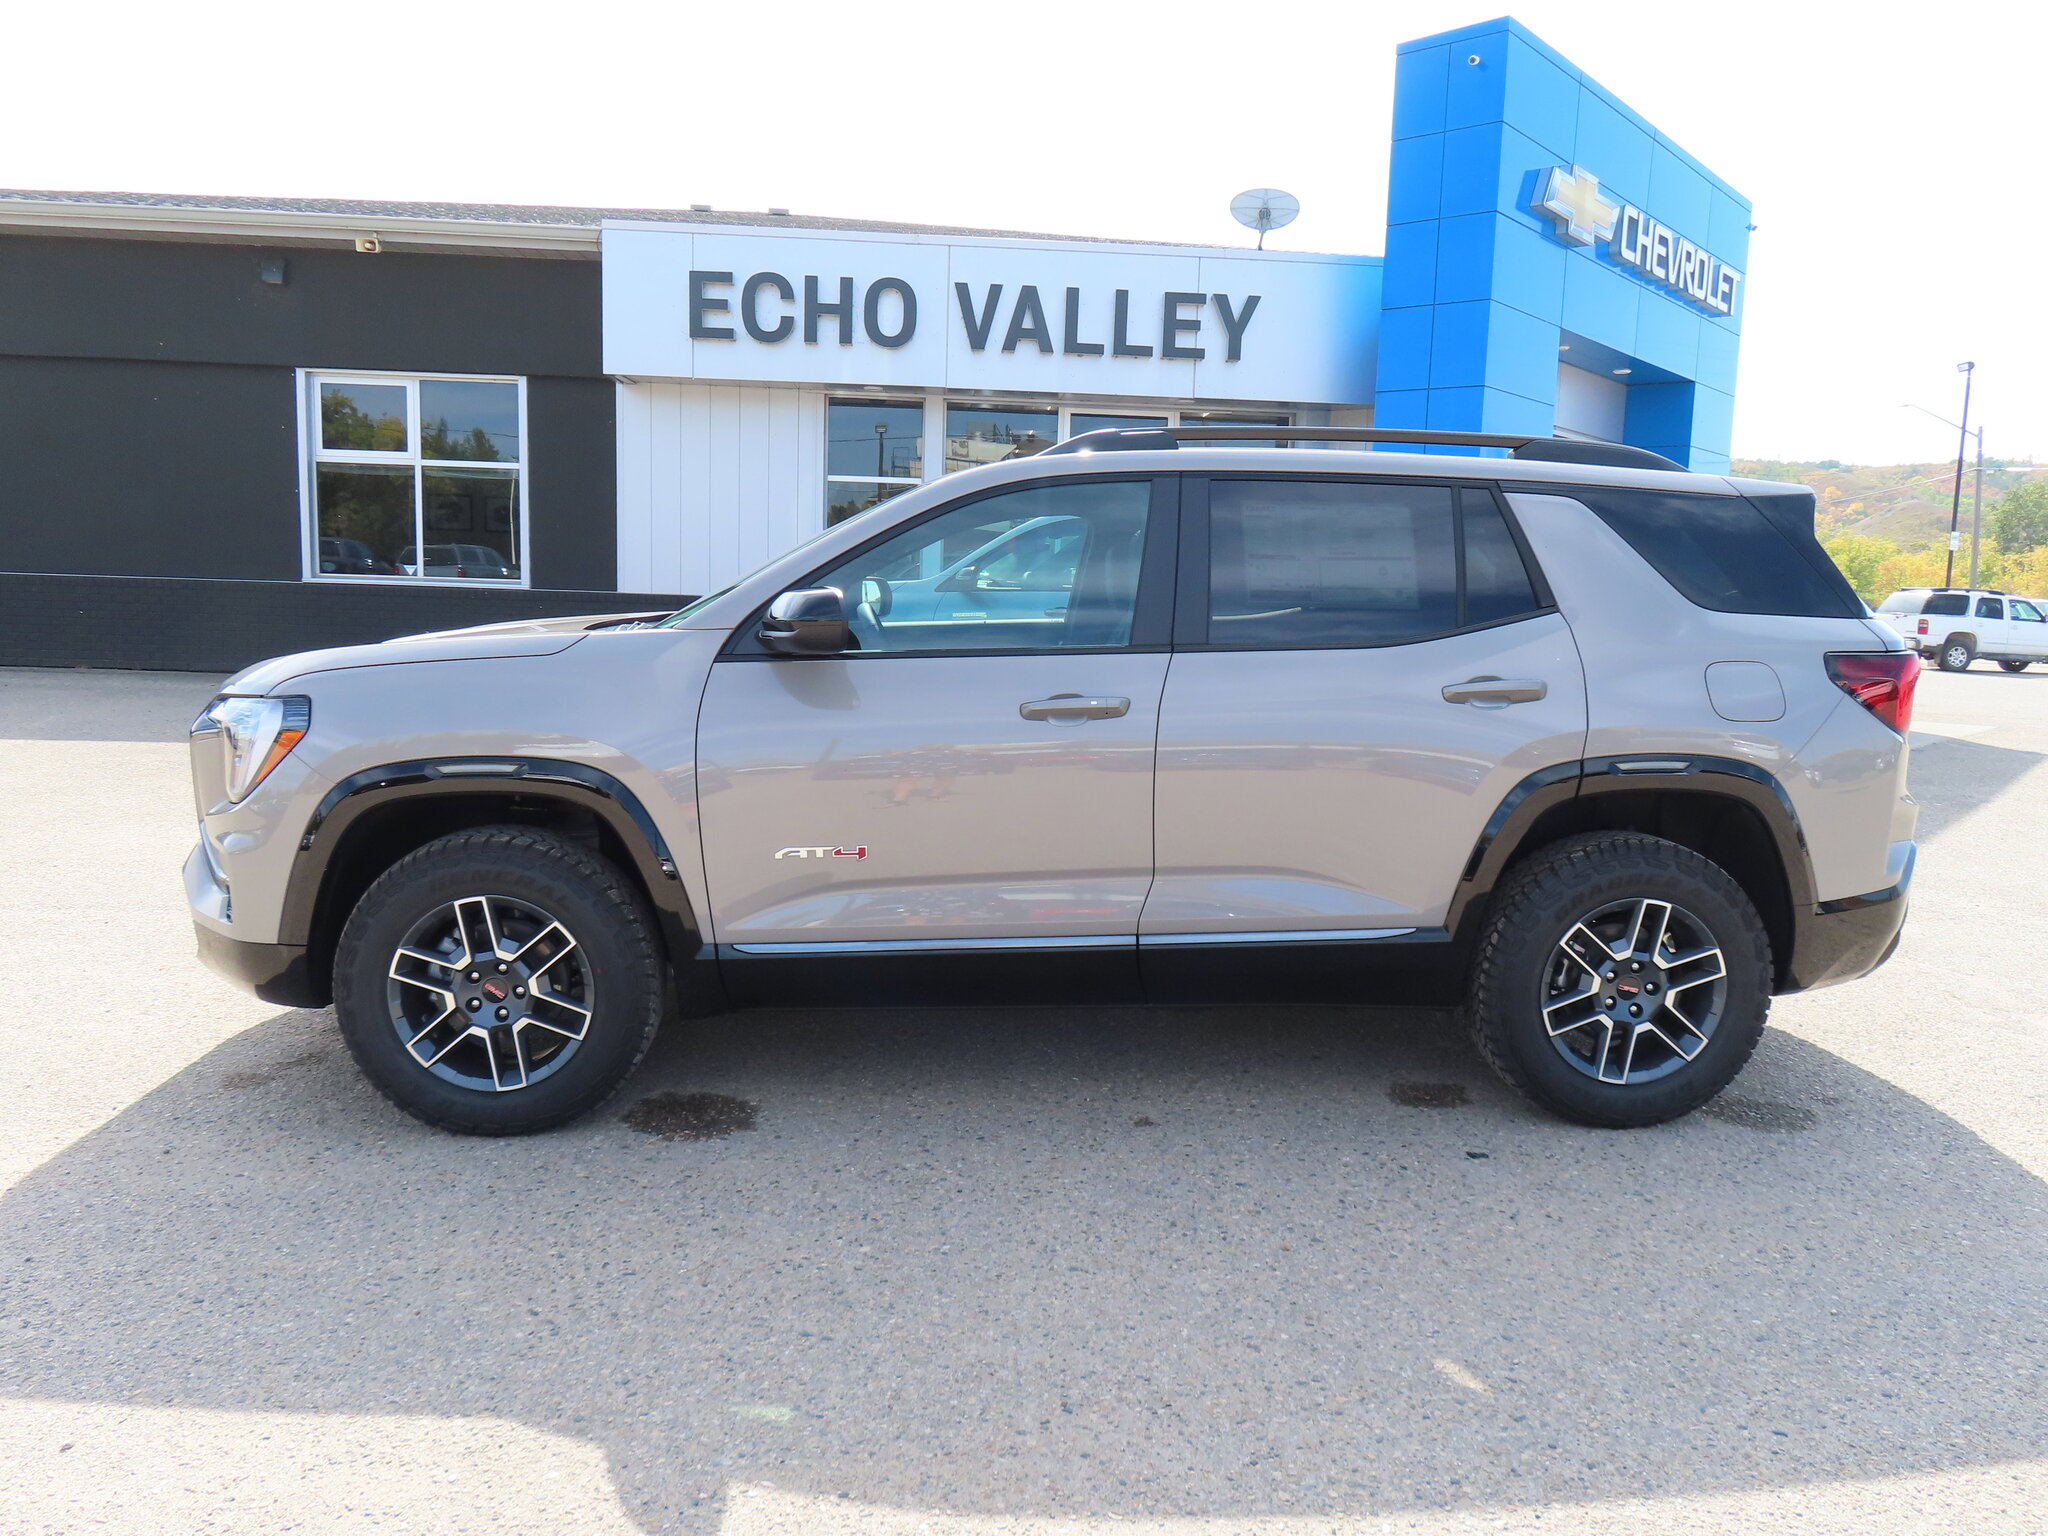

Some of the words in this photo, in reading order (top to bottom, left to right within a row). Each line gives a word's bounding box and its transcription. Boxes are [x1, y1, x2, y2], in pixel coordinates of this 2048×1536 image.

[1617, 204, 1741, 316] CHEVROLET
[688, 270, 918, 348] ECHO
[953, 281, 1262, 363] VALLEY
[774, 845, 868, 860] AT4
[484, 983, 506, 999] GMC
